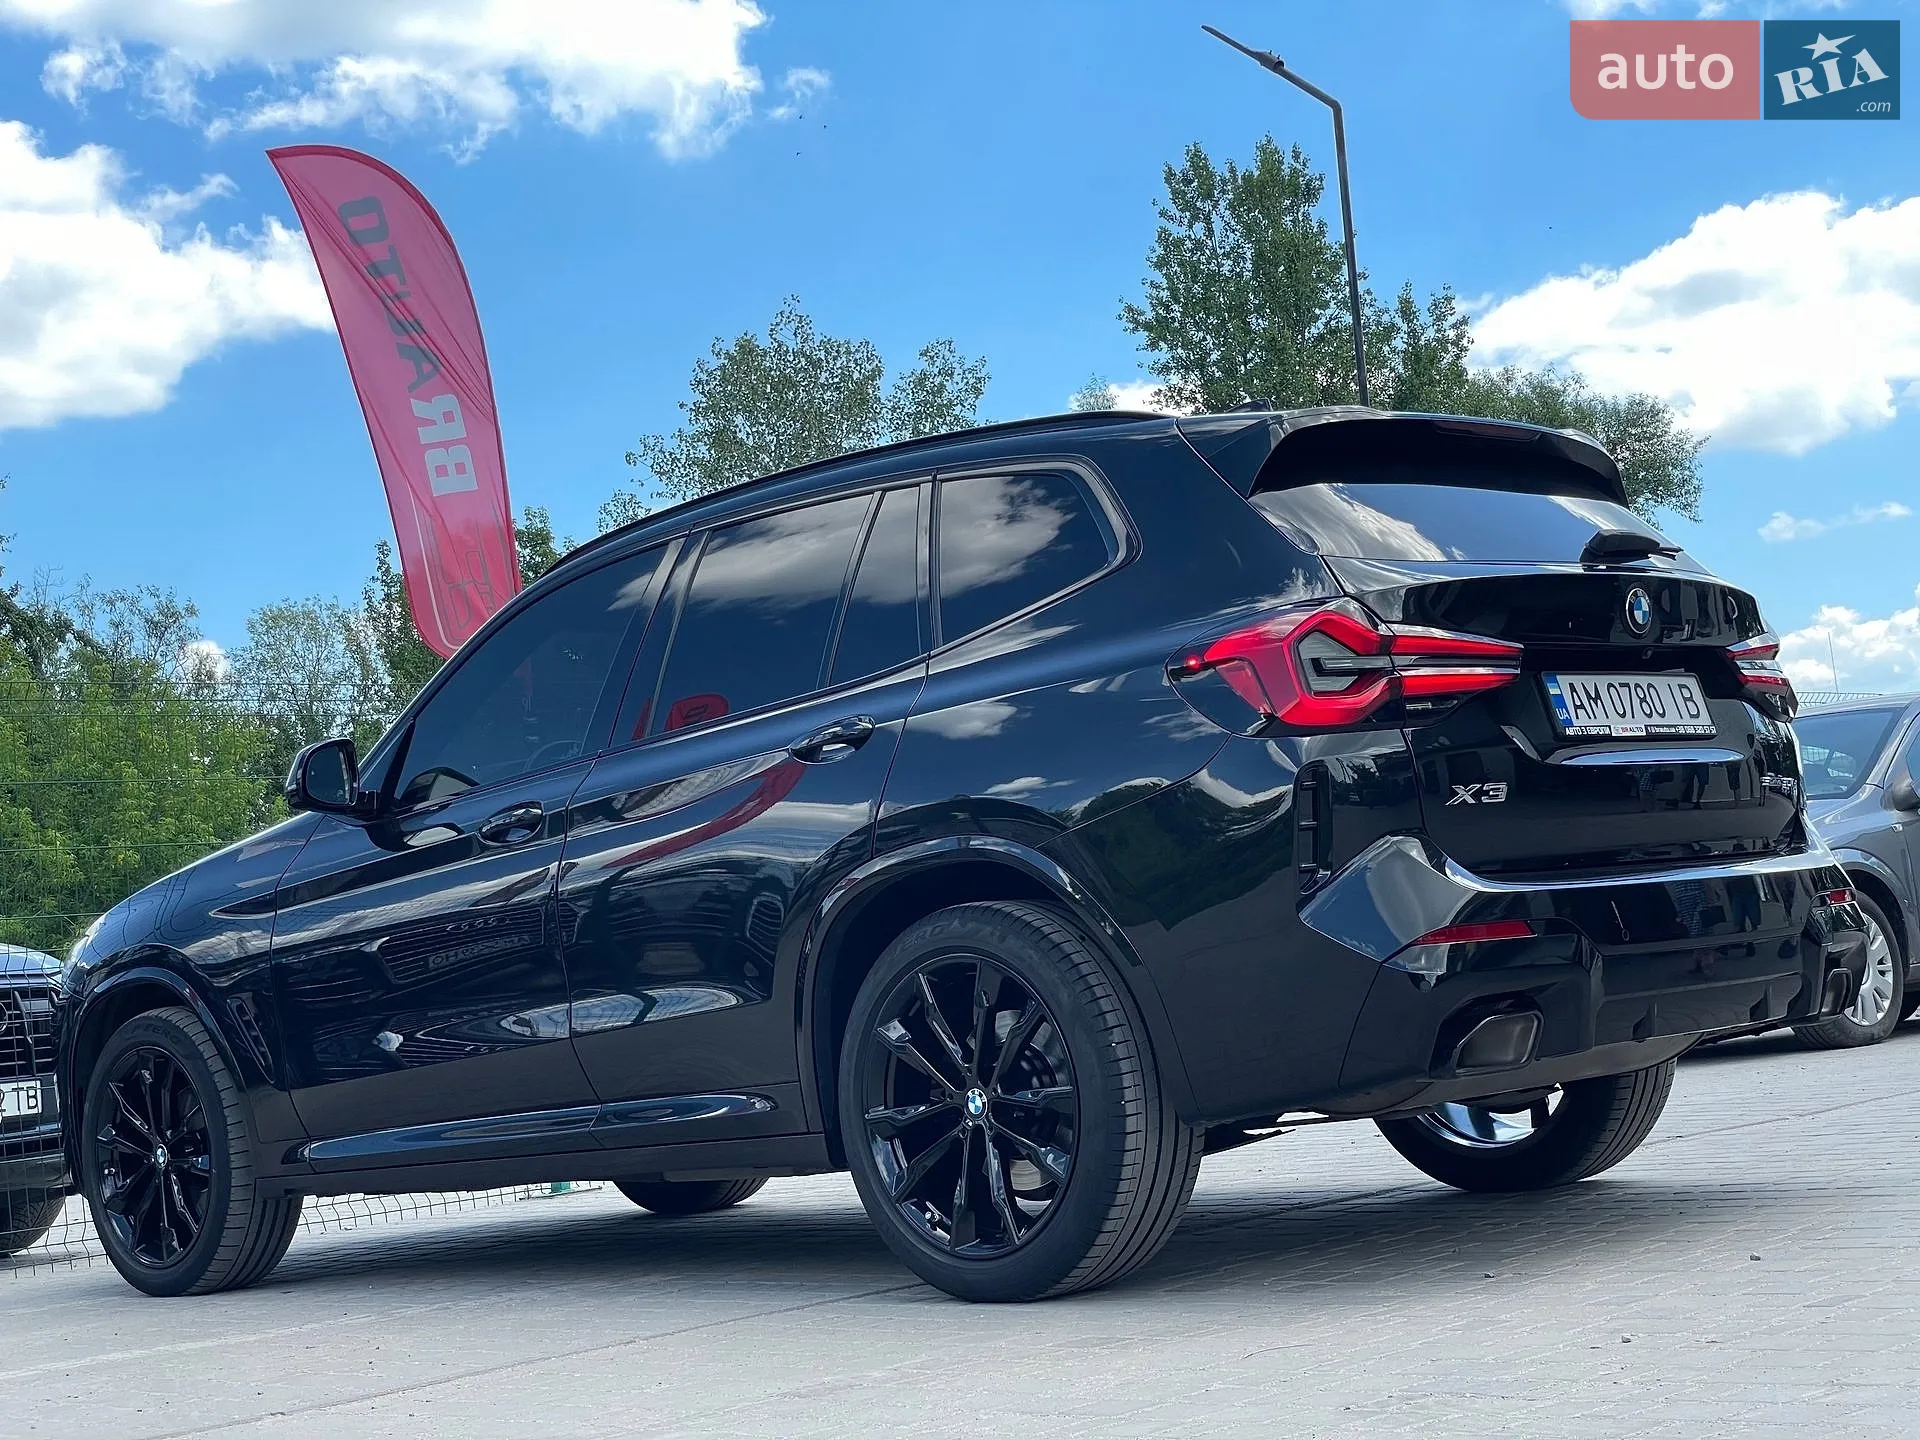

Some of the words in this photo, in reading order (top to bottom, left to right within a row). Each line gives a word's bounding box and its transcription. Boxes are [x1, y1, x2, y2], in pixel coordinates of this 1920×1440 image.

[1568, 682, 1609, 720] AM
[1607, 682, 1667, 719] 0780
[1668, 683, 1701, 720] IB
[1556, 708, 1570, 721] UA
[1445, 782, 1507, 805] X3
